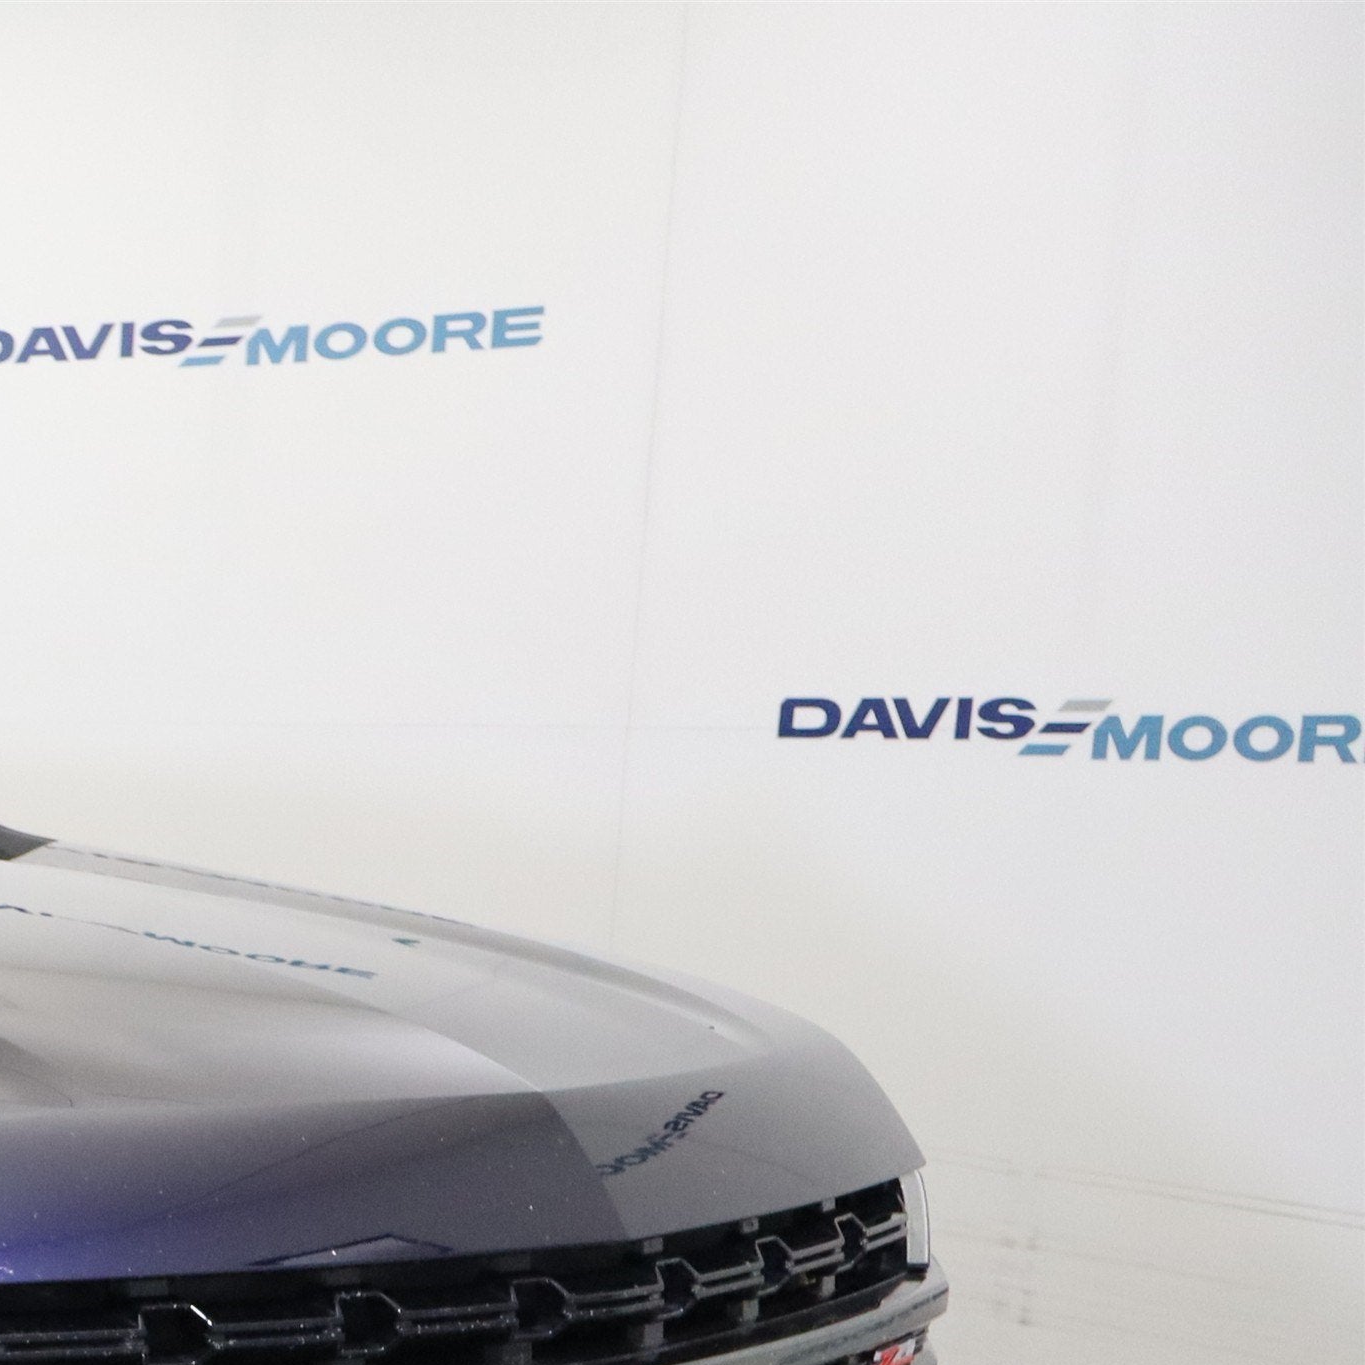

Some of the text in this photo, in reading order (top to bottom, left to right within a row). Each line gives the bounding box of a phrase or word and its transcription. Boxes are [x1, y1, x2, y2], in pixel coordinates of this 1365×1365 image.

[245, 305, 545, 366] MOORE
[777, 695, 1365, 764] DAVIS MOOR
